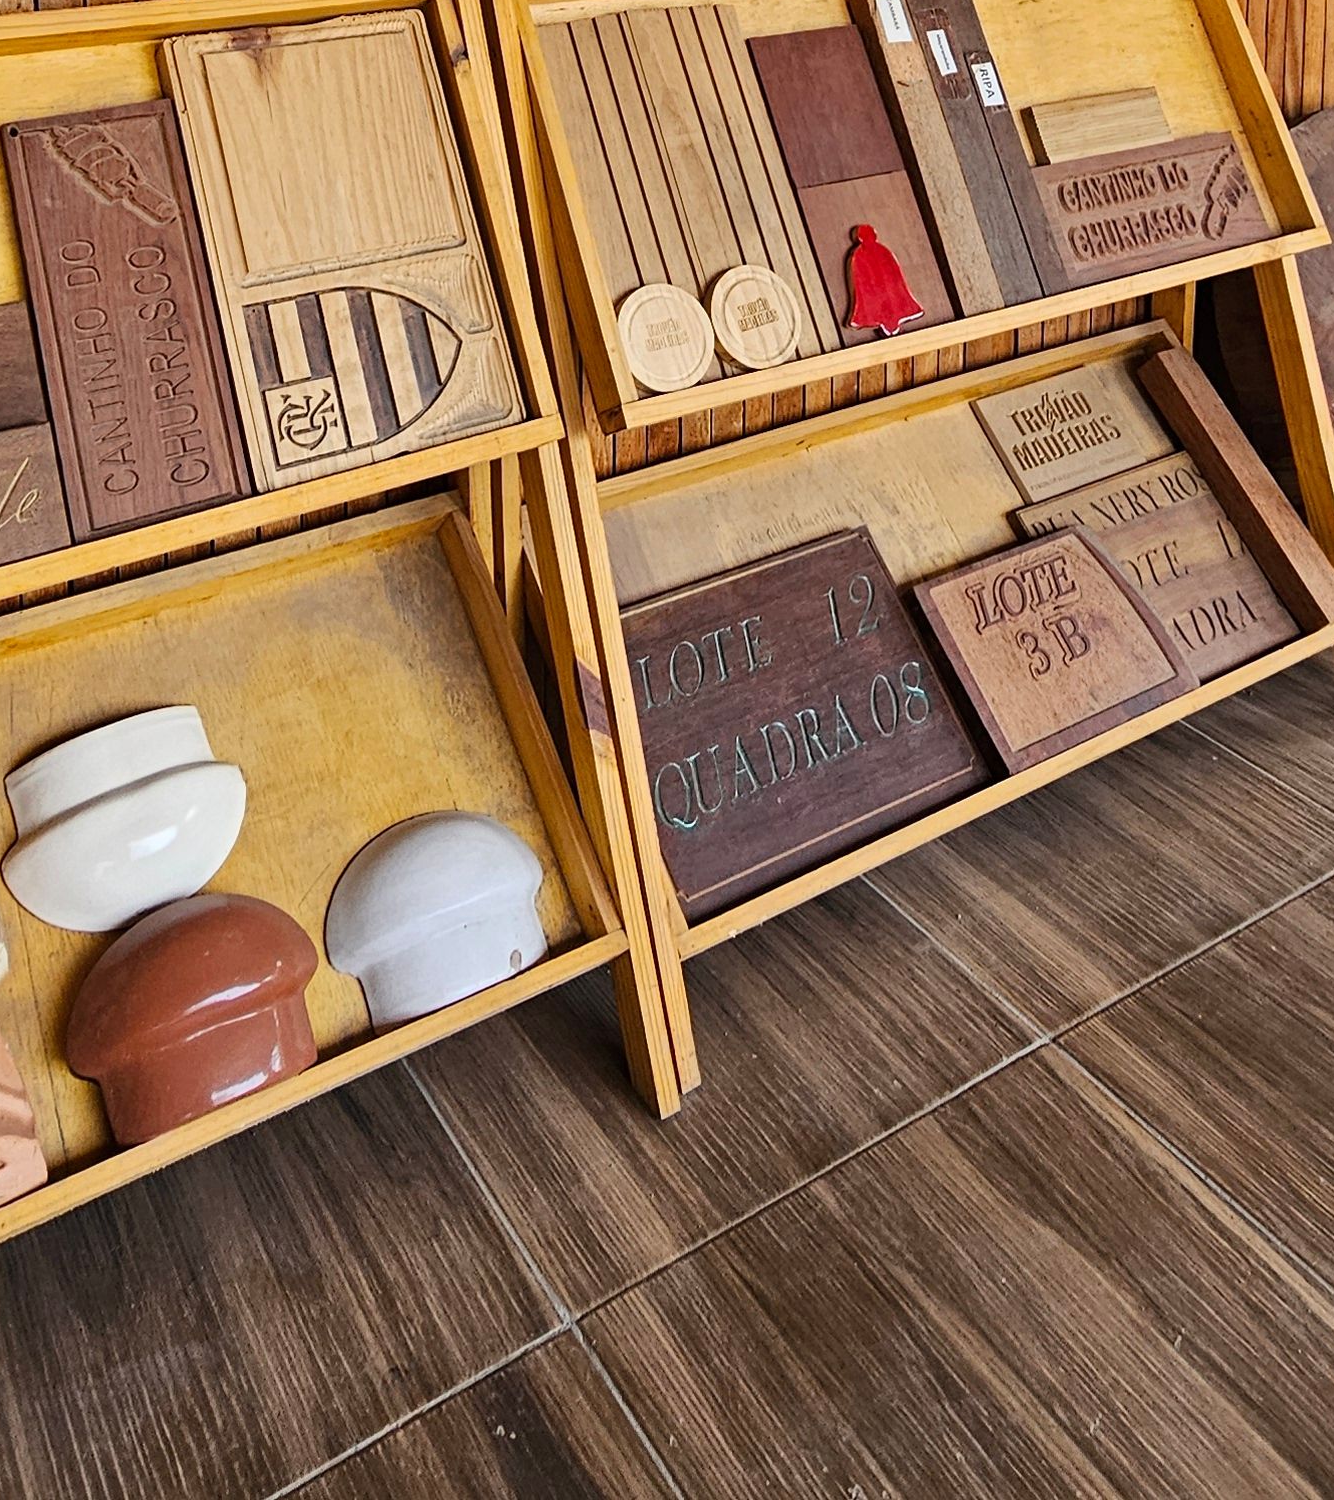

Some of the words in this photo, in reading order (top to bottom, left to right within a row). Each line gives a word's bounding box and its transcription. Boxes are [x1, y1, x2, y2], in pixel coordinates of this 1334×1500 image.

[979, 68, 995, 99] RIPA
[60, 239, 101, 287] DO
[73, 307, 139, 495] CANTINHO
[126, 245, 209, 487] CHURRASCO
[1012, 414, 1122, 472] MADEIRAS
[1090, 479, 1161, 530] NERY
[965, 554, 1080, 636] LOTE
[635, 615, 773, 713] LOTE
[823, 574, 885, 646] 12
[654, 694, 867, 831] QUADRA
[869, 660, 932, 739] 08
